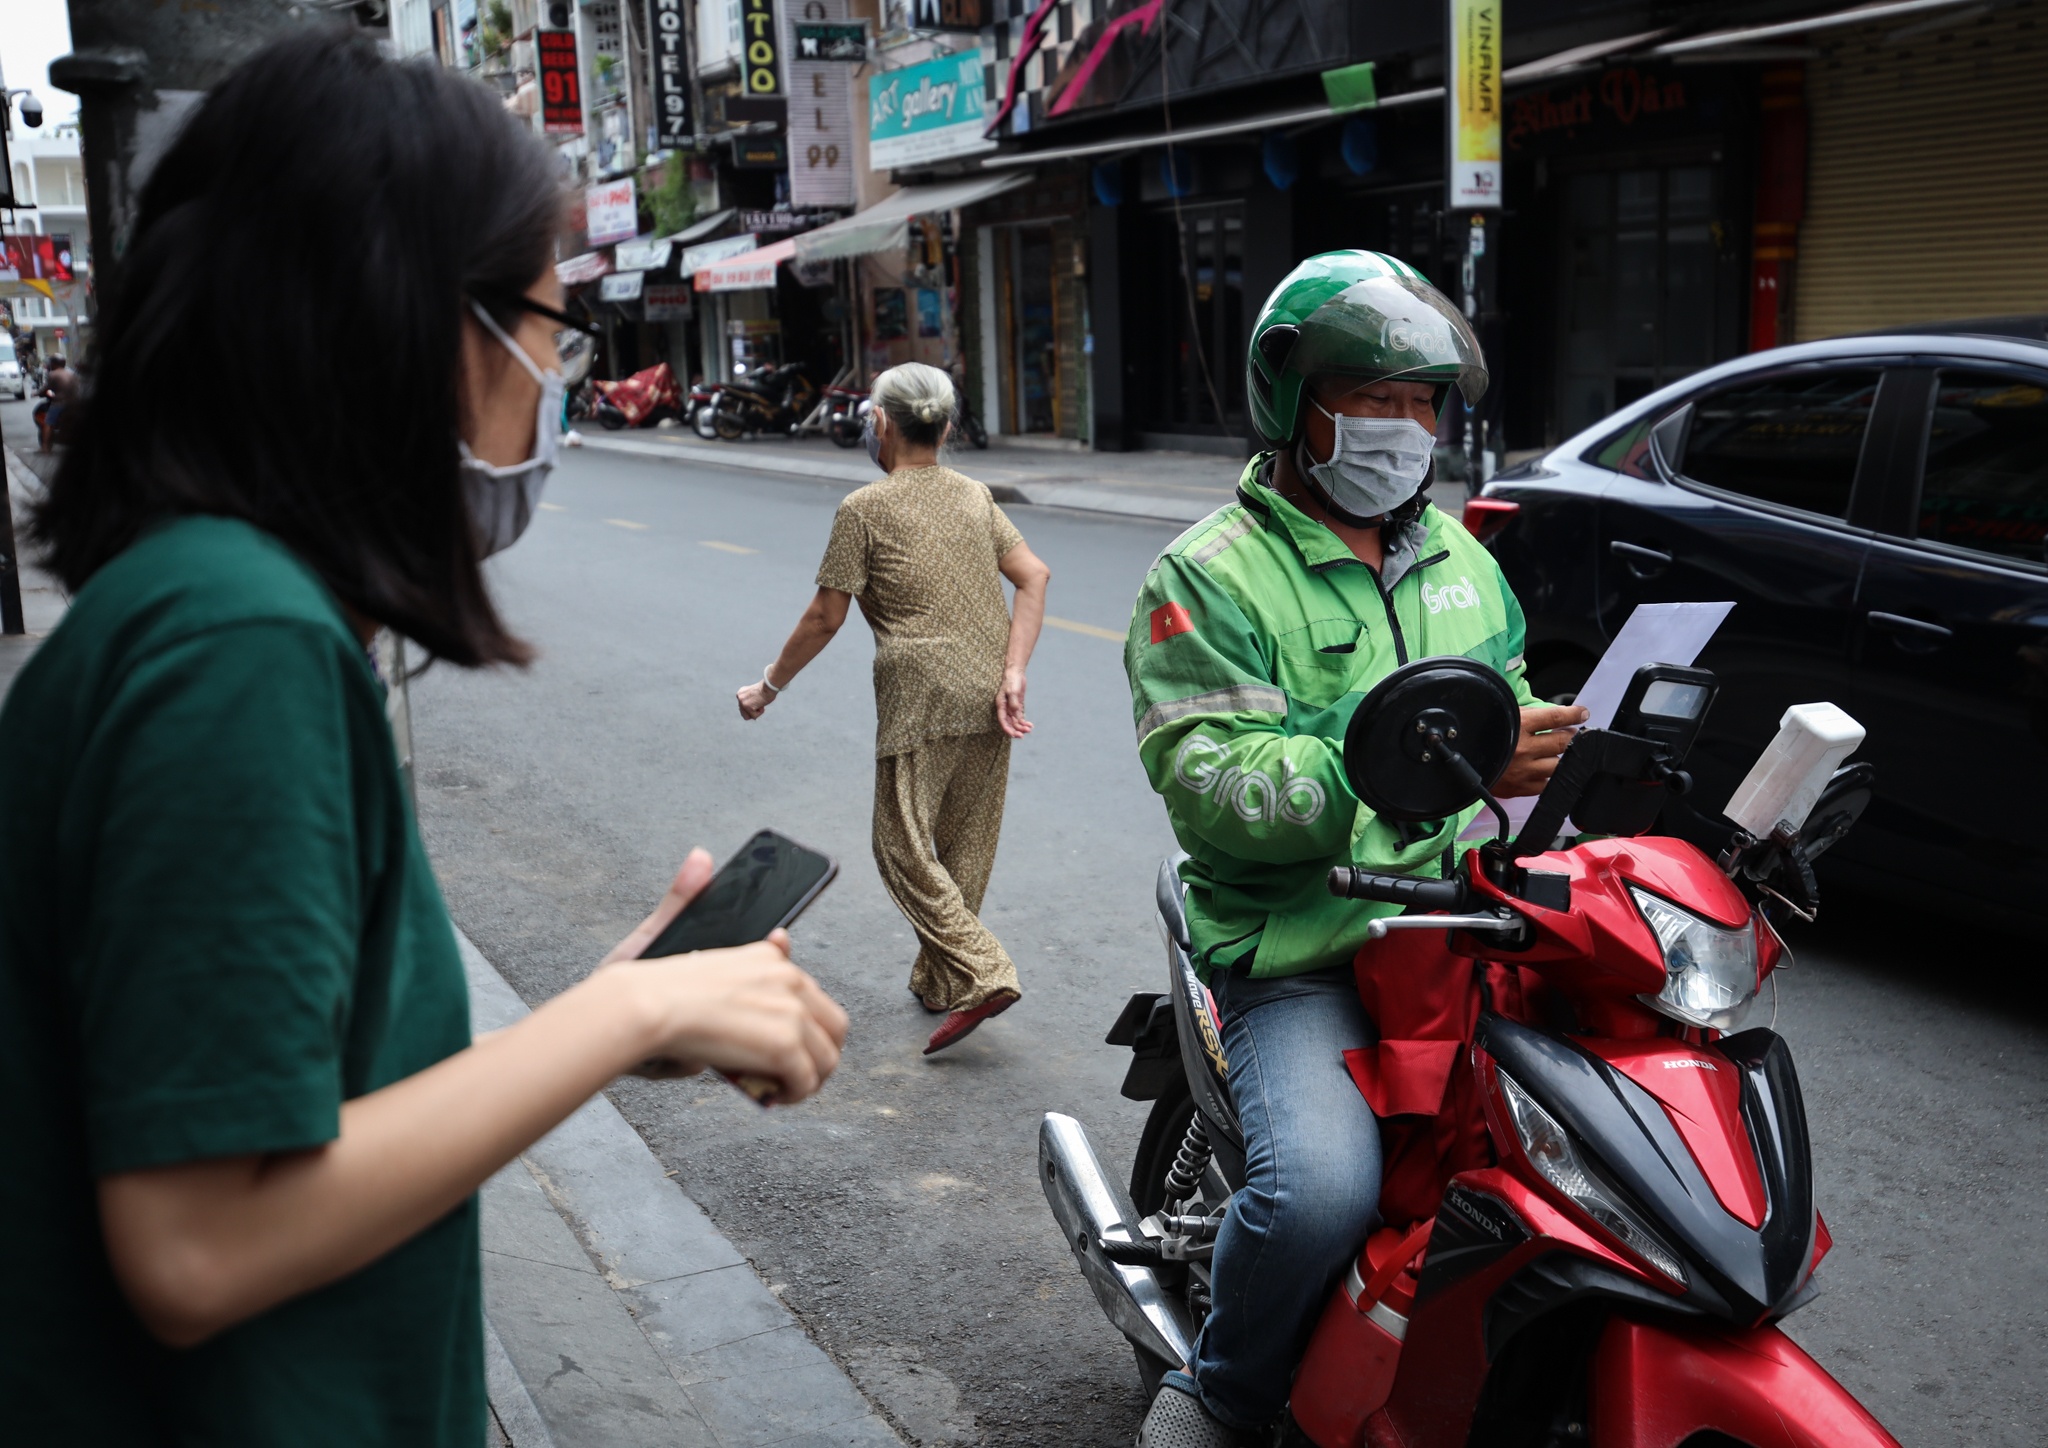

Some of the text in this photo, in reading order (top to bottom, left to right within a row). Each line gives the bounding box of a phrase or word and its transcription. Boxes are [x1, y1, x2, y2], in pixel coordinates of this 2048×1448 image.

[541, 52, 576, 67] BEER
[1479, 7, 1494, 113] VINAMA
[543, 70, 579, 104] 91
[871, 76, 958, 132] ART gallery
[1388, 326, 1447, 354] Grab
[1174, 734, 1326, 826] Grab
[1195, 1007, 1230, 1080] RSX
[1662, 1060, 1719, 1071] HONDA
[1450, 1191, 1503, 1240] HONDA
